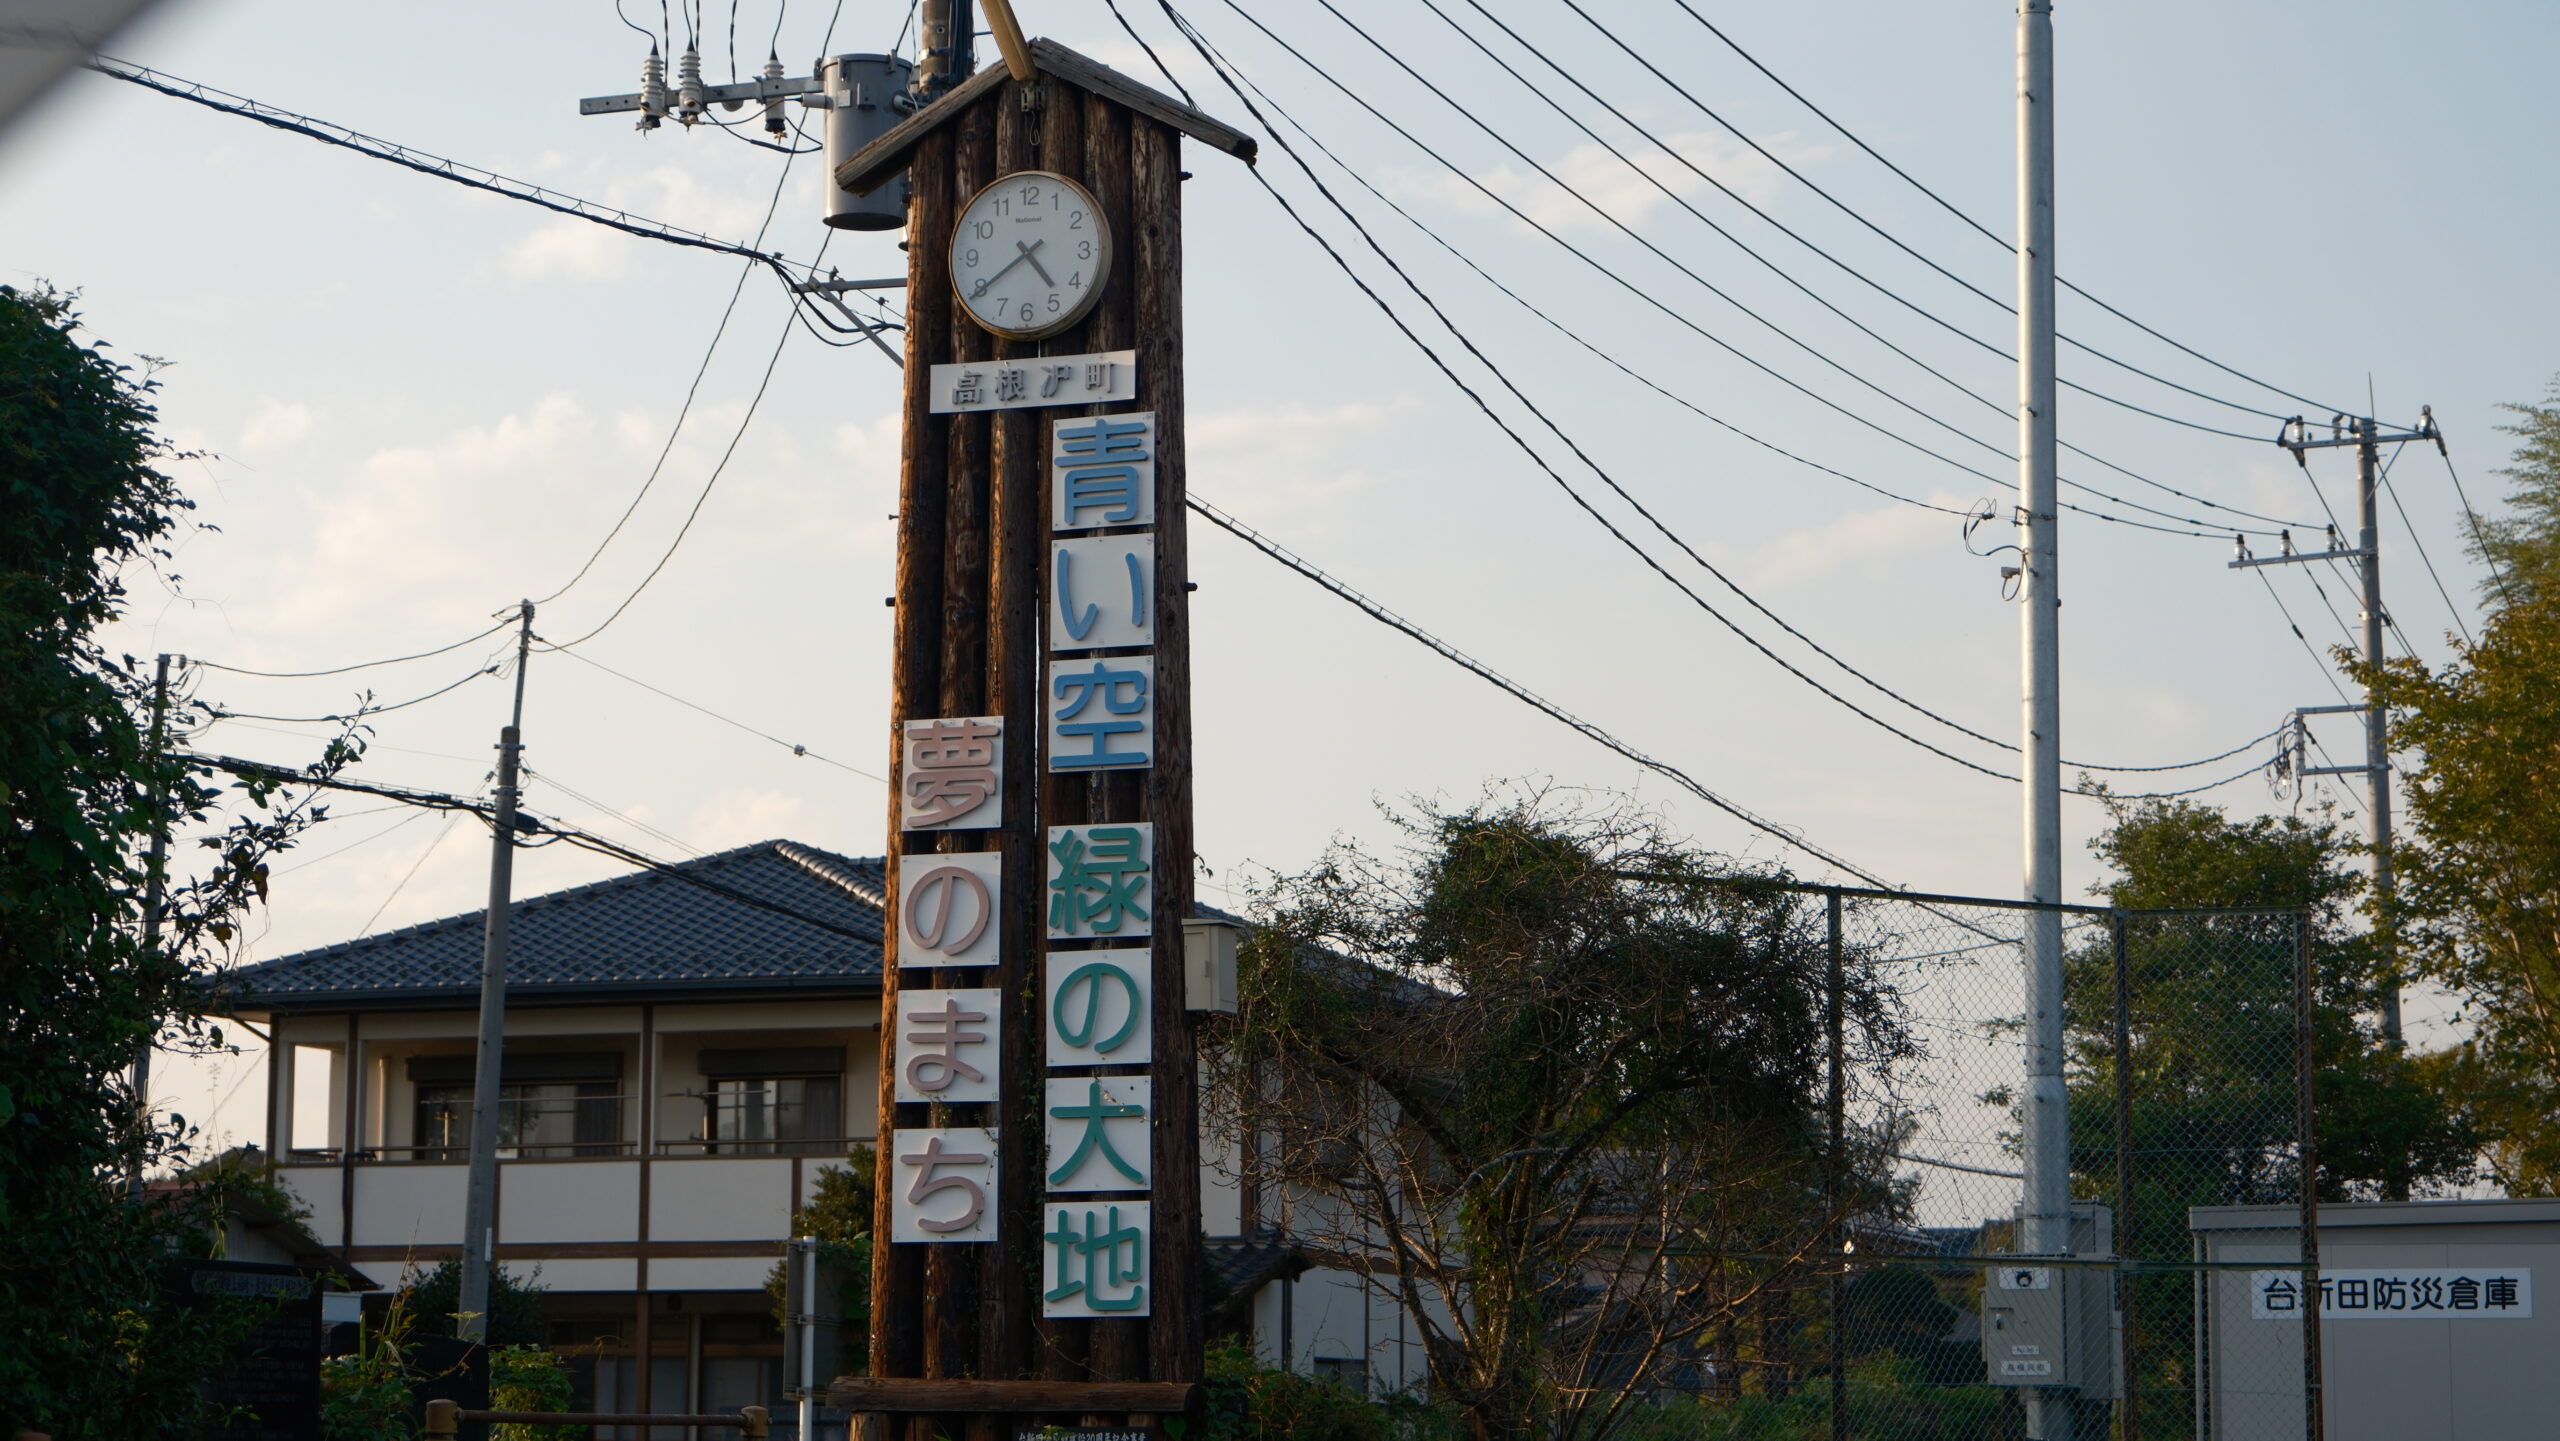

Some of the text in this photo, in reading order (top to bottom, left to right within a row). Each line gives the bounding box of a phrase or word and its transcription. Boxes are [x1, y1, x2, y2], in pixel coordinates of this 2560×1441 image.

[1019, 186, 1040, 206] 12
[1051, 192, 1059, 211] 1
[992, 198, 1009, 217] 11
[973, 220, 994, 240] 10
[1069, 211, 1083, 230] 2
[965, 249, 979, 268] 9
[1077, 240, 1091, 260] 3
[974, 278, 988, 298] 8
[1068, 271, 1082, 290] 4
[996, 298, 1009, 317] 7
[1020, 302, 1034, 322] 6
[1047, 293, 1061, 312] 5
[1043, 418, 1150, 1312] 青い空 緑の大地
[900, 719, 1001, 1233] 夢のまち
